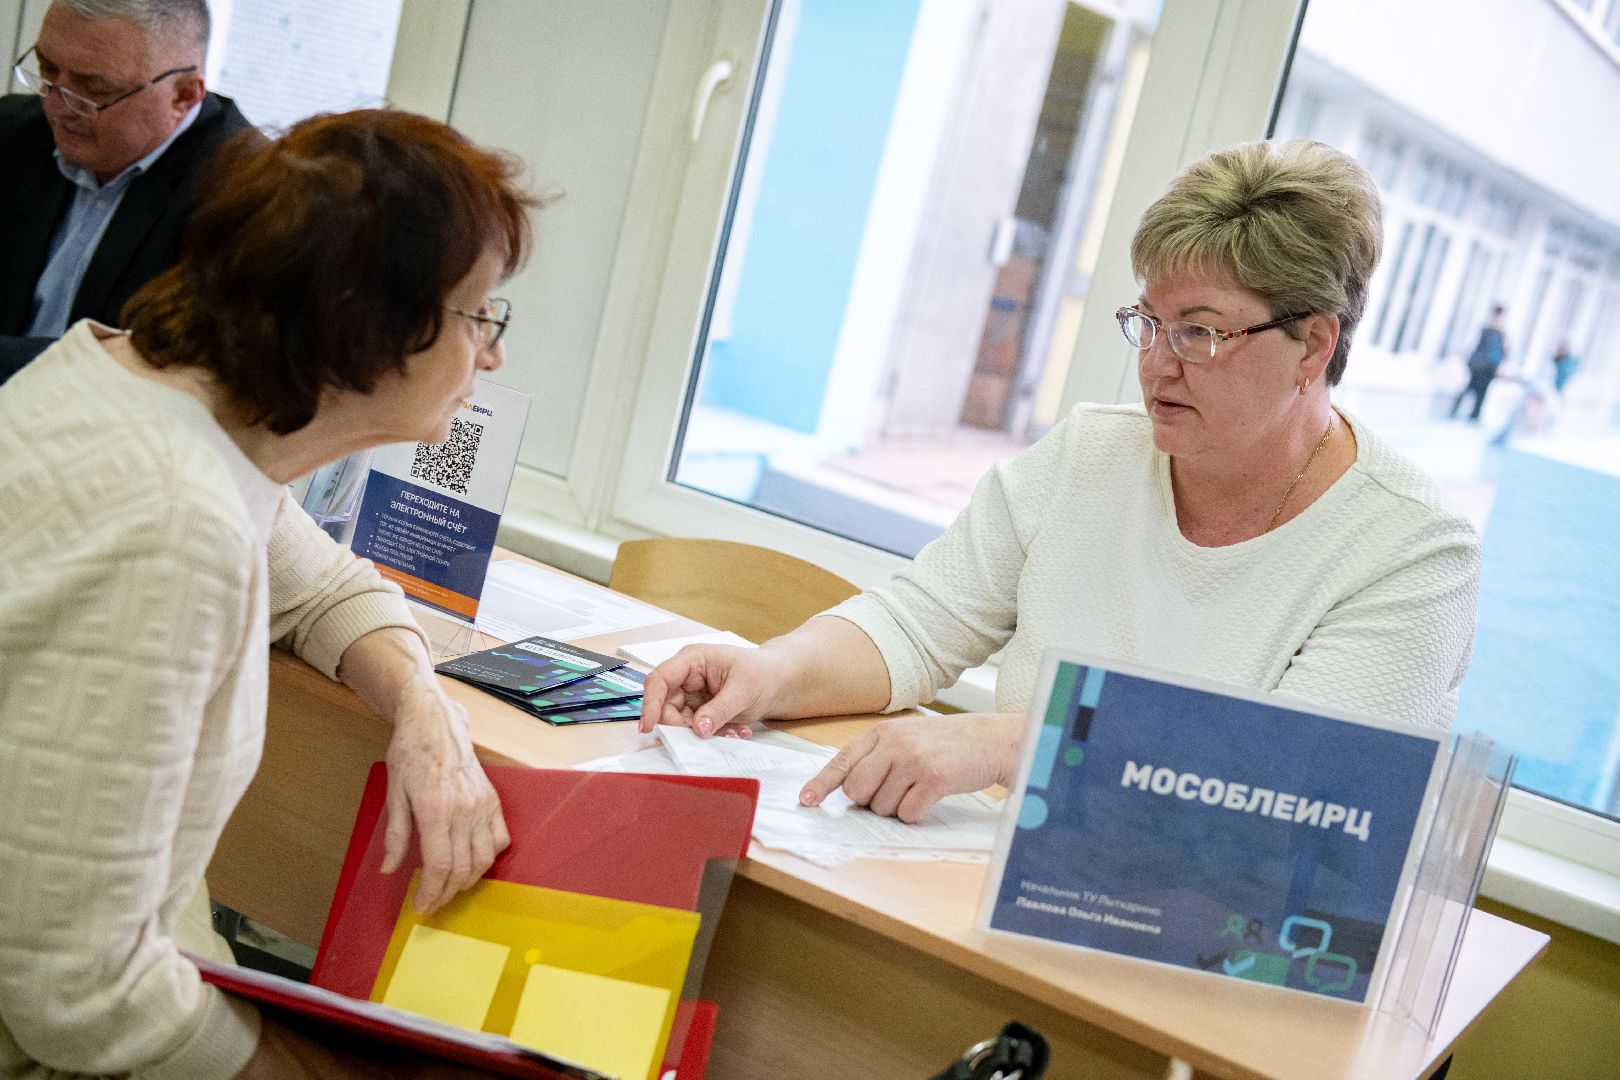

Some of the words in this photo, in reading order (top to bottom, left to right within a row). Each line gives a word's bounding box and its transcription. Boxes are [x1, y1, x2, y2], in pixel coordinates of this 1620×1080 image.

[390, 500, 447, 527] ЭЛЕКТРОННЫЙ
[447, 521, 467, 534] СЧЁТ
[400, 490, 449, 514] ПЕРЕХОДИТЕ
[449, 507, 460, 518] НА
[1120, 759, 1373, 842] МОСОБЛЕИРЦ
[1083, 890, 1097, 903] ТУ
[1068, 906, 1103, 923] Ольга
